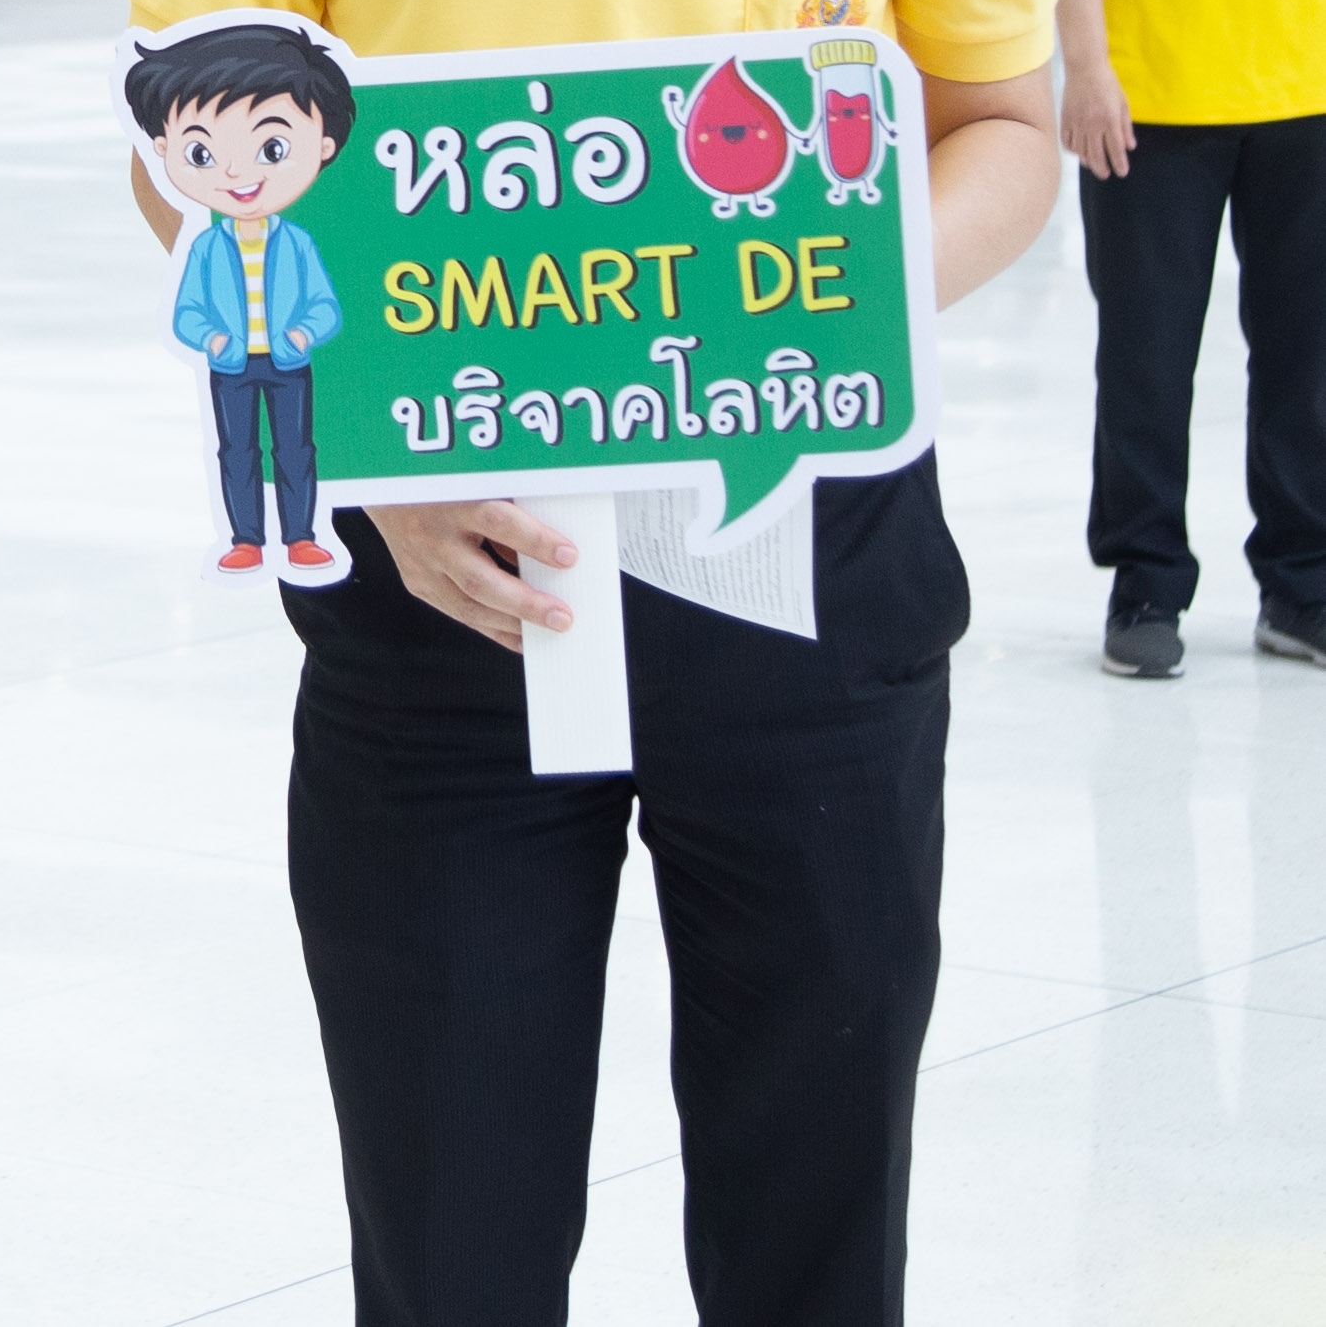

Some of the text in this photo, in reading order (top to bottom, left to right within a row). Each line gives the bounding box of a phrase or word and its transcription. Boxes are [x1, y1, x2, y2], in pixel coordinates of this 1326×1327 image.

[374, 80, 650, 215] หล่อ
[383, 235, 854, 334] SMART DE
[391, 335, 885, 453] บริจาคโลหิต
